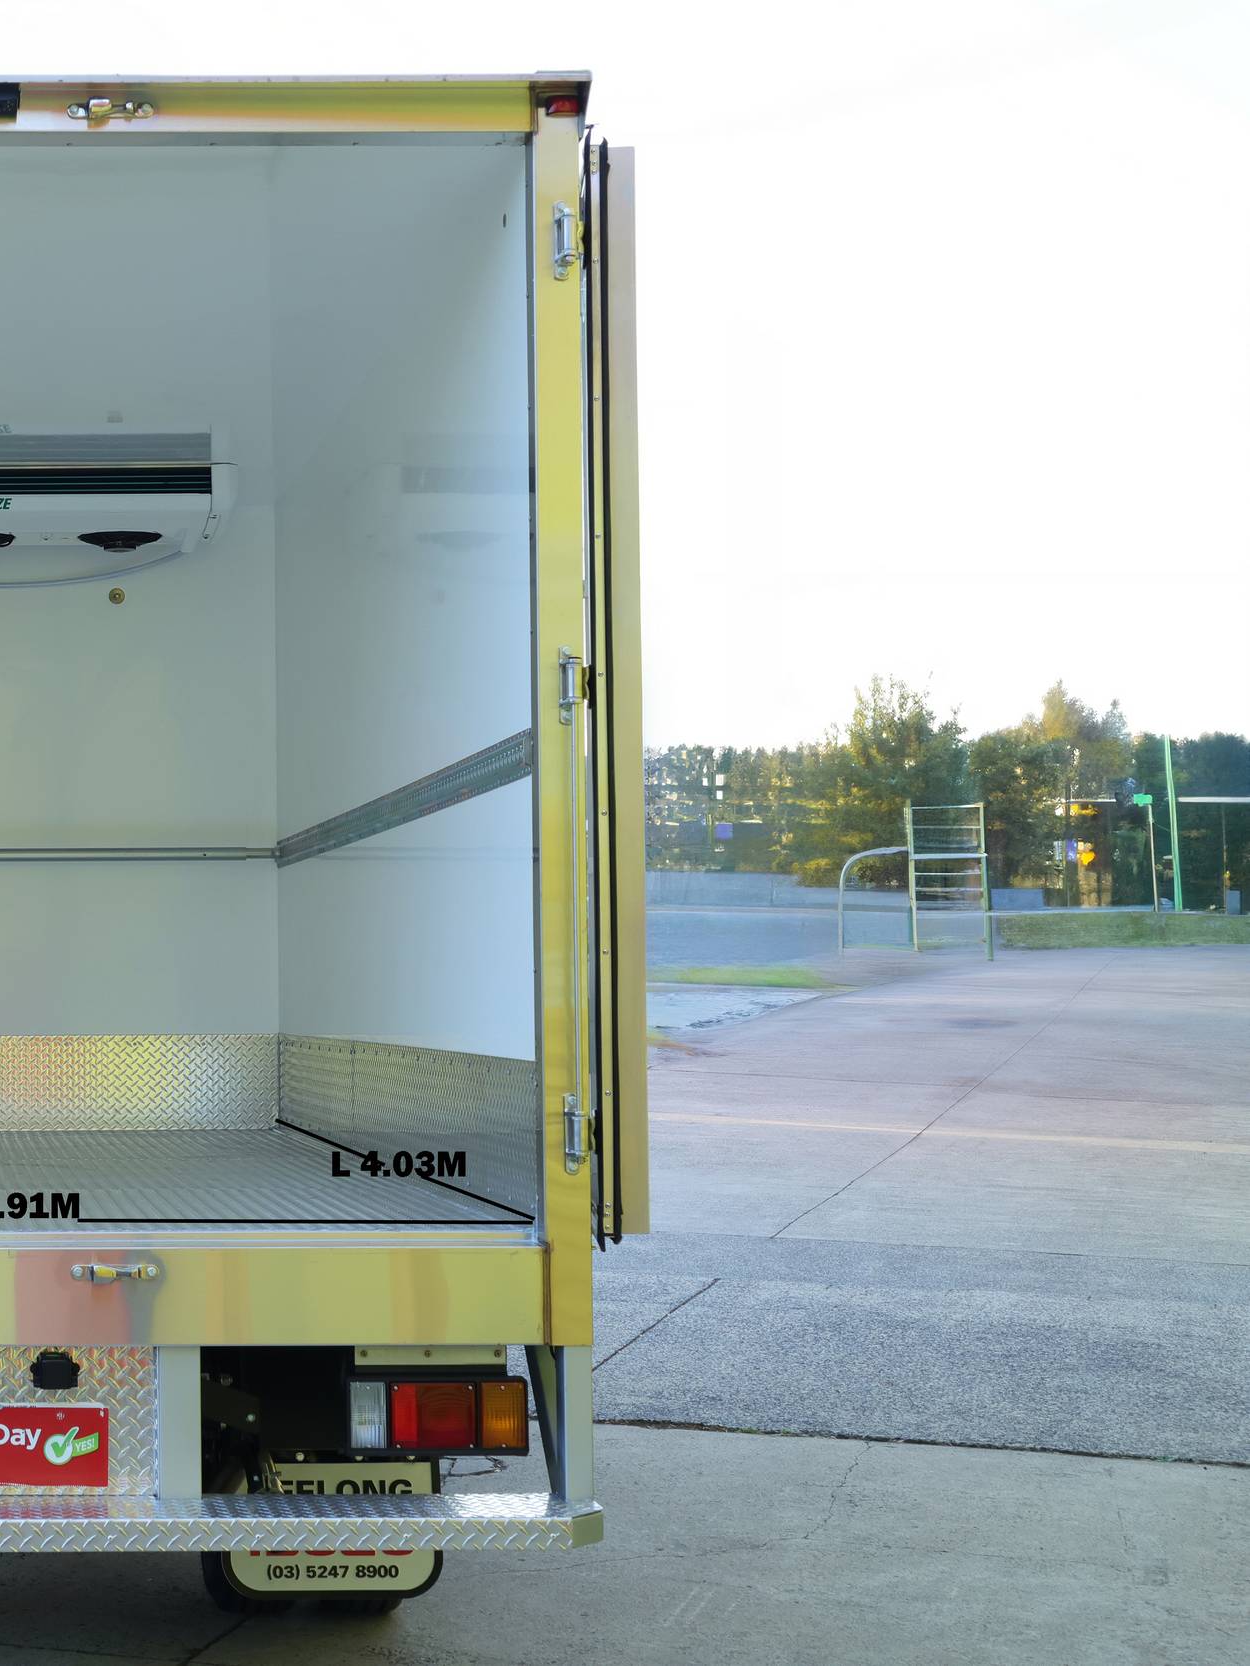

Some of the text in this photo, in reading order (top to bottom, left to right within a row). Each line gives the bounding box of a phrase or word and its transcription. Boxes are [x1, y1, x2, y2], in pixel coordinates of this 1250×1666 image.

[75, 1437, 96, 1453] YES!
[280, 1479, 413, 1495] EELONG
[267, 1564, 399, 1580] (03) 5247 8900
